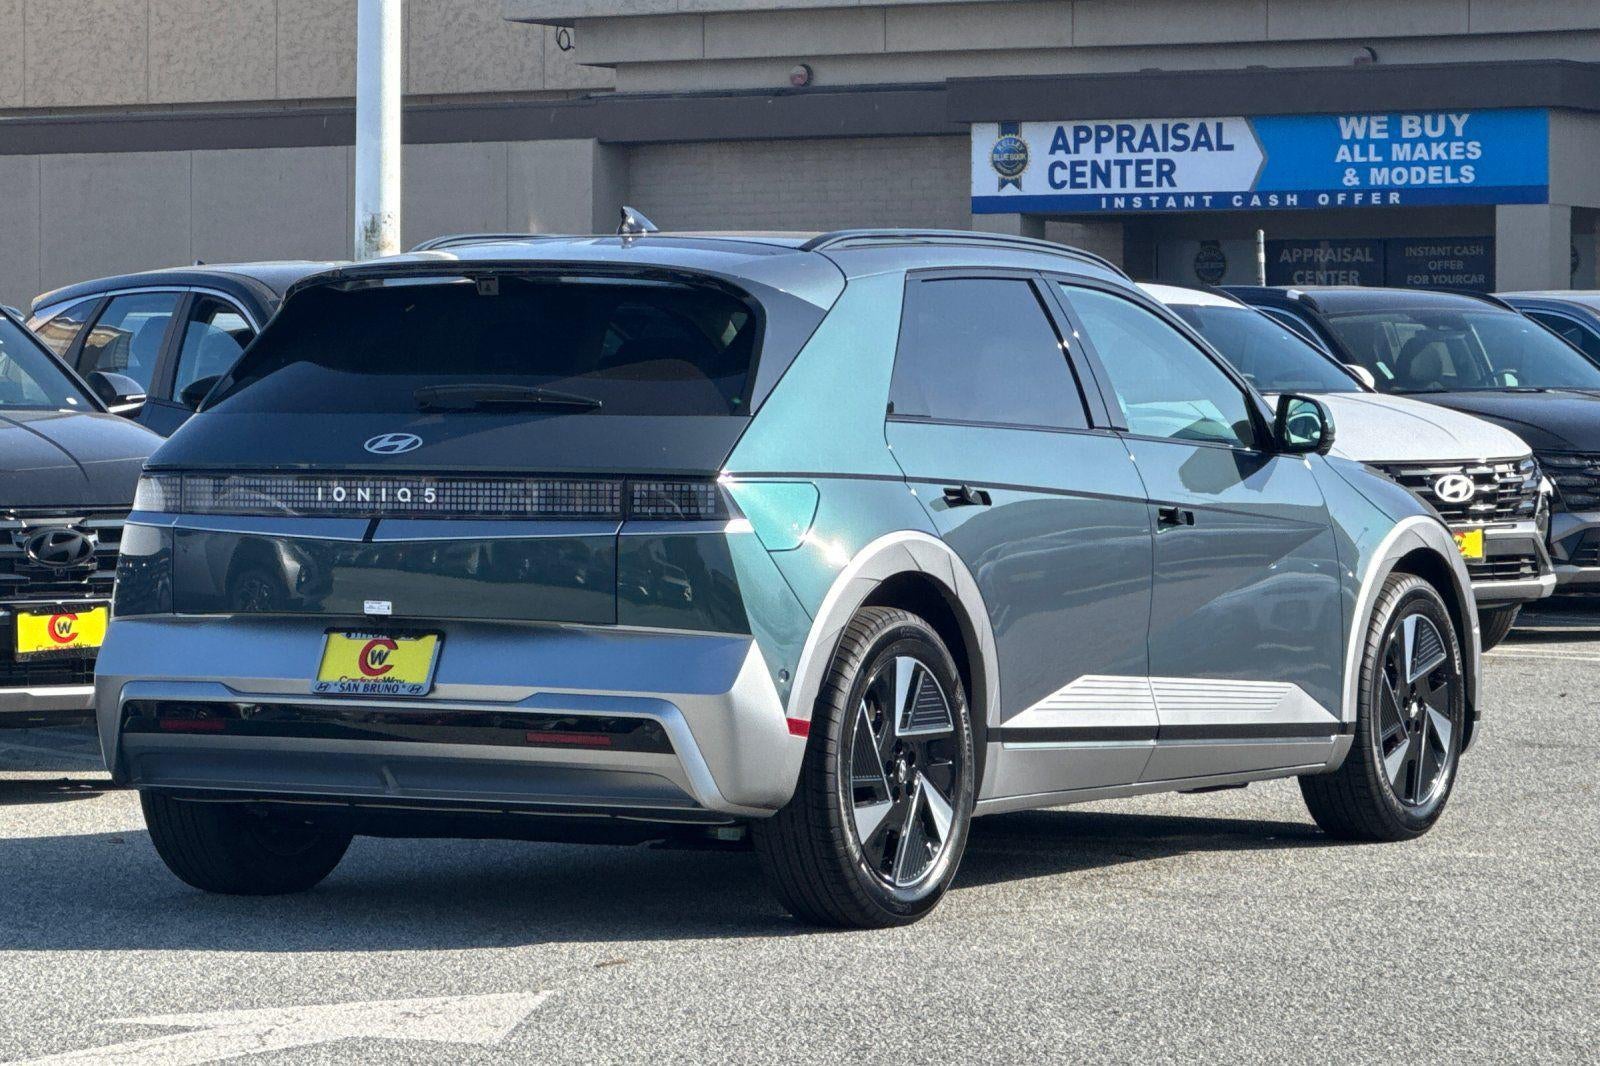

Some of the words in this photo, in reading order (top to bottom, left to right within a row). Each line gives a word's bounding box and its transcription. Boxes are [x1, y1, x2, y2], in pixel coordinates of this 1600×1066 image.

[1339, 115, 1389, 140] WE
[1401, 113, 1471, 139] BUY
[1048, 121, 1235, 156] APPRAISAL
[1335, 143, 1383, 163] ALL
[1391, 141, 1483, 162] MAKES
[1048, 158, 1178, 191] CENTER
[1342, 166, 1360, 187] &
[1369, 165, 1476, 186] MODELS
[1101, 194, 1214, 209] INSTANT
[1232, 193, 1298, 208] CASH
[1317, 191, 1402, 206] OFFER
[1279, 247, 1374, 263] APPRAISAL
[1405, 246, 1453, 257] INSTANT
[1454, 245, 1484, 256] CASH
[1428, 260, 1465, 270] OFFER
[1292, 269, 1360, 286] CENTER
[1406, 274, 1430, 285] FOR
[317, 486, 412, 503] IONIQ
[424, 487, 437, 503] 5
[338, 682, 360, 692] SAN
[362, 683, 400, 693] BRUNO
